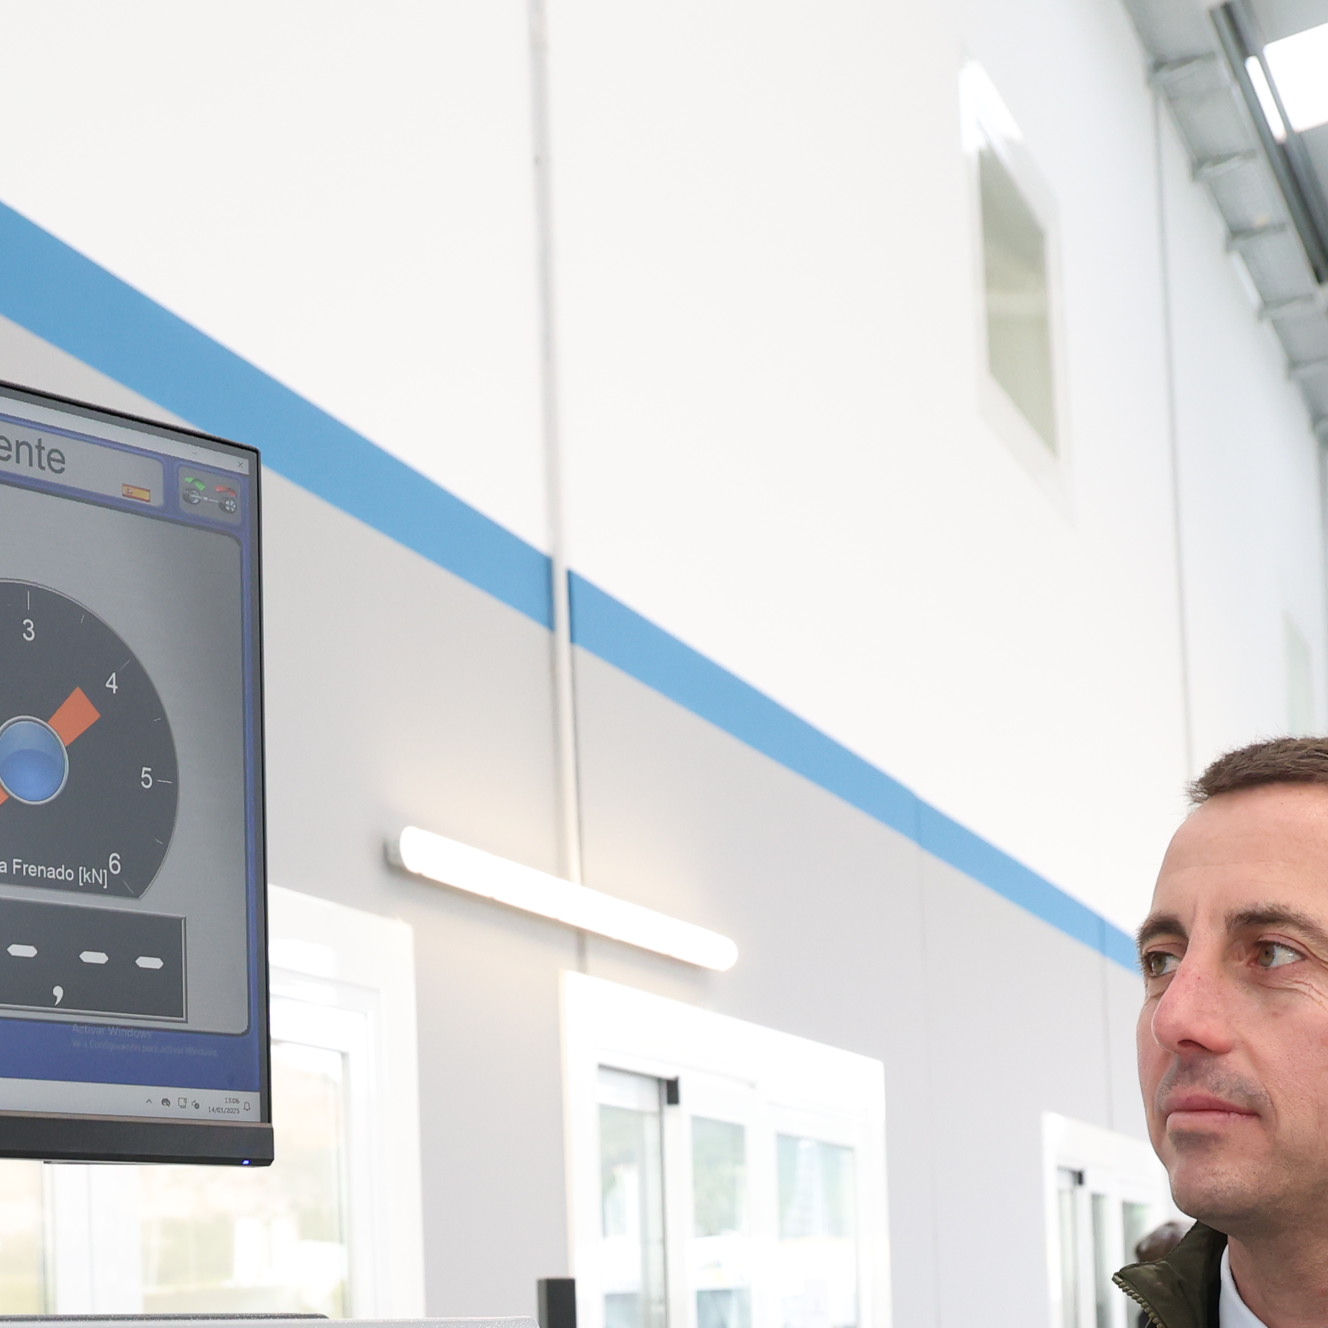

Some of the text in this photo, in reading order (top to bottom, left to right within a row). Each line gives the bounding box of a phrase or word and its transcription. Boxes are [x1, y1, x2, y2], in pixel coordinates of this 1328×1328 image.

[22, 618, 35, 642] 3
[105, 672, 119, 695] 4
[141, 767, 153, 789] 5
[12, 859, 74, 881] Frenado
[79, 866, 108, 889] [kN]
[109, 853, 121, 875] 6
